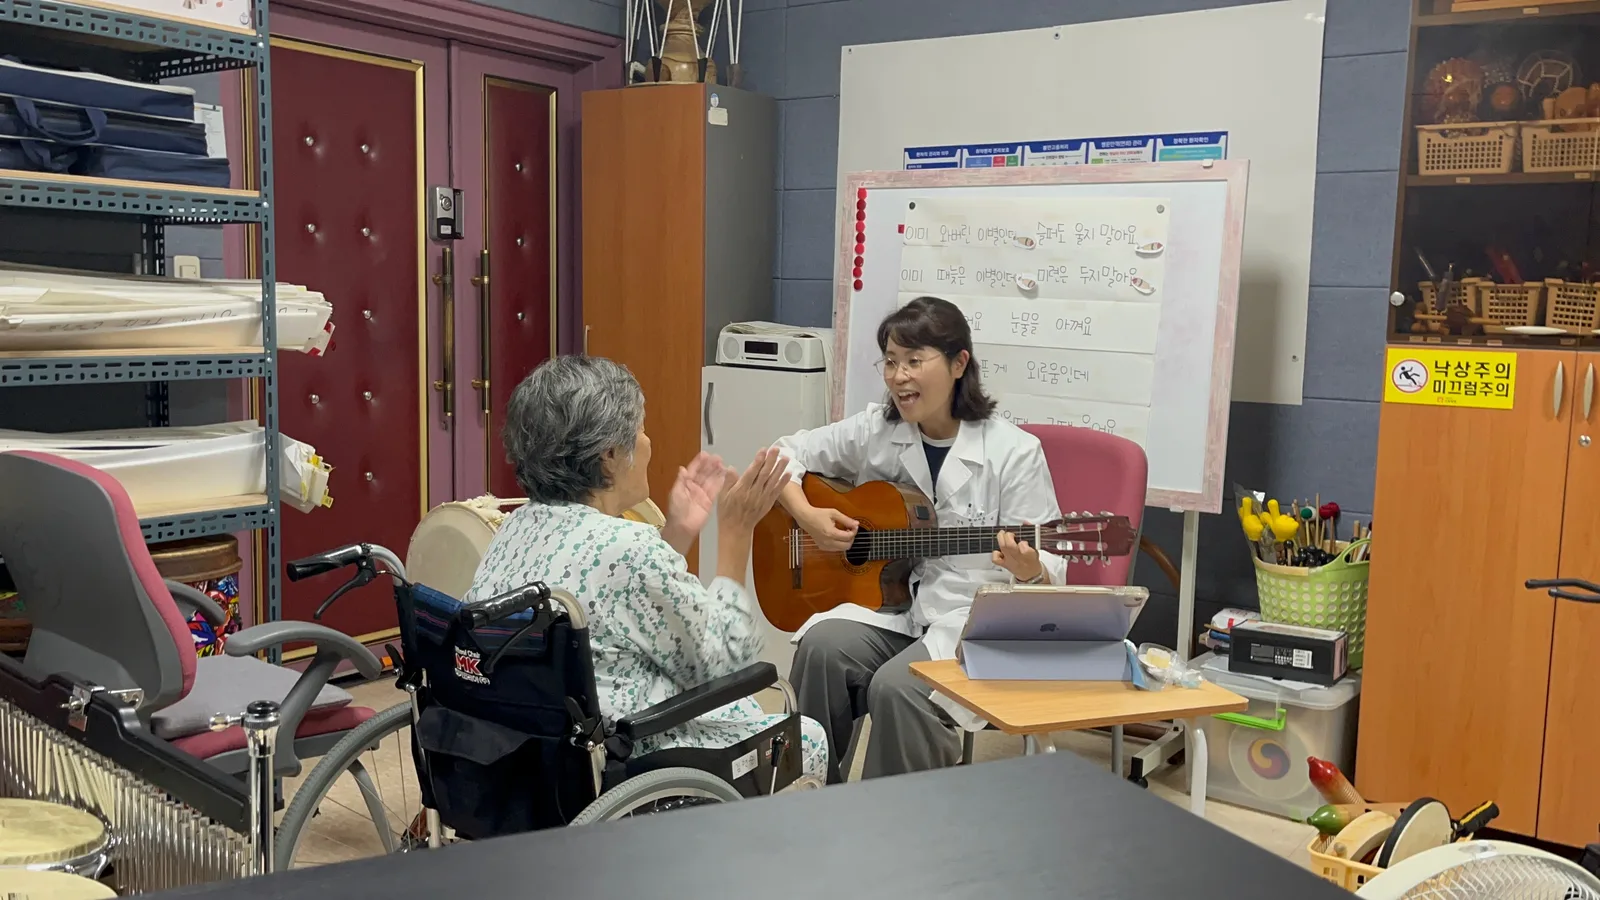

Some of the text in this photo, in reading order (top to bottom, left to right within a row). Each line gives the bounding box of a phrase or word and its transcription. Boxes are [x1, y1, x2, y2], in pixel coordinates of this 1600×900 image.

[905, 226, 929, 240] 이미
[939, 225, 971, 244] 와버린
[1036, 221, 1066, 246] 슬퍼도
[1075, 222, 1095, 246] 울지
[1100, 223, 1137, 246] 말아요
[901, 268, 924, 283] 이미
[936, 265, 967, 286] 때늦은
[1037, 265, 1069, 284] 미련은
[1011, 311, 1040, 337] 눈물을
[1055, 316, 1092, 336] 아껴요
[1026, 360, 1089, 385] 외로움인데
[1434, 360, 1511, 380] 낙상주의
[1432, 380, 1510, 397] 미끄럼주의
